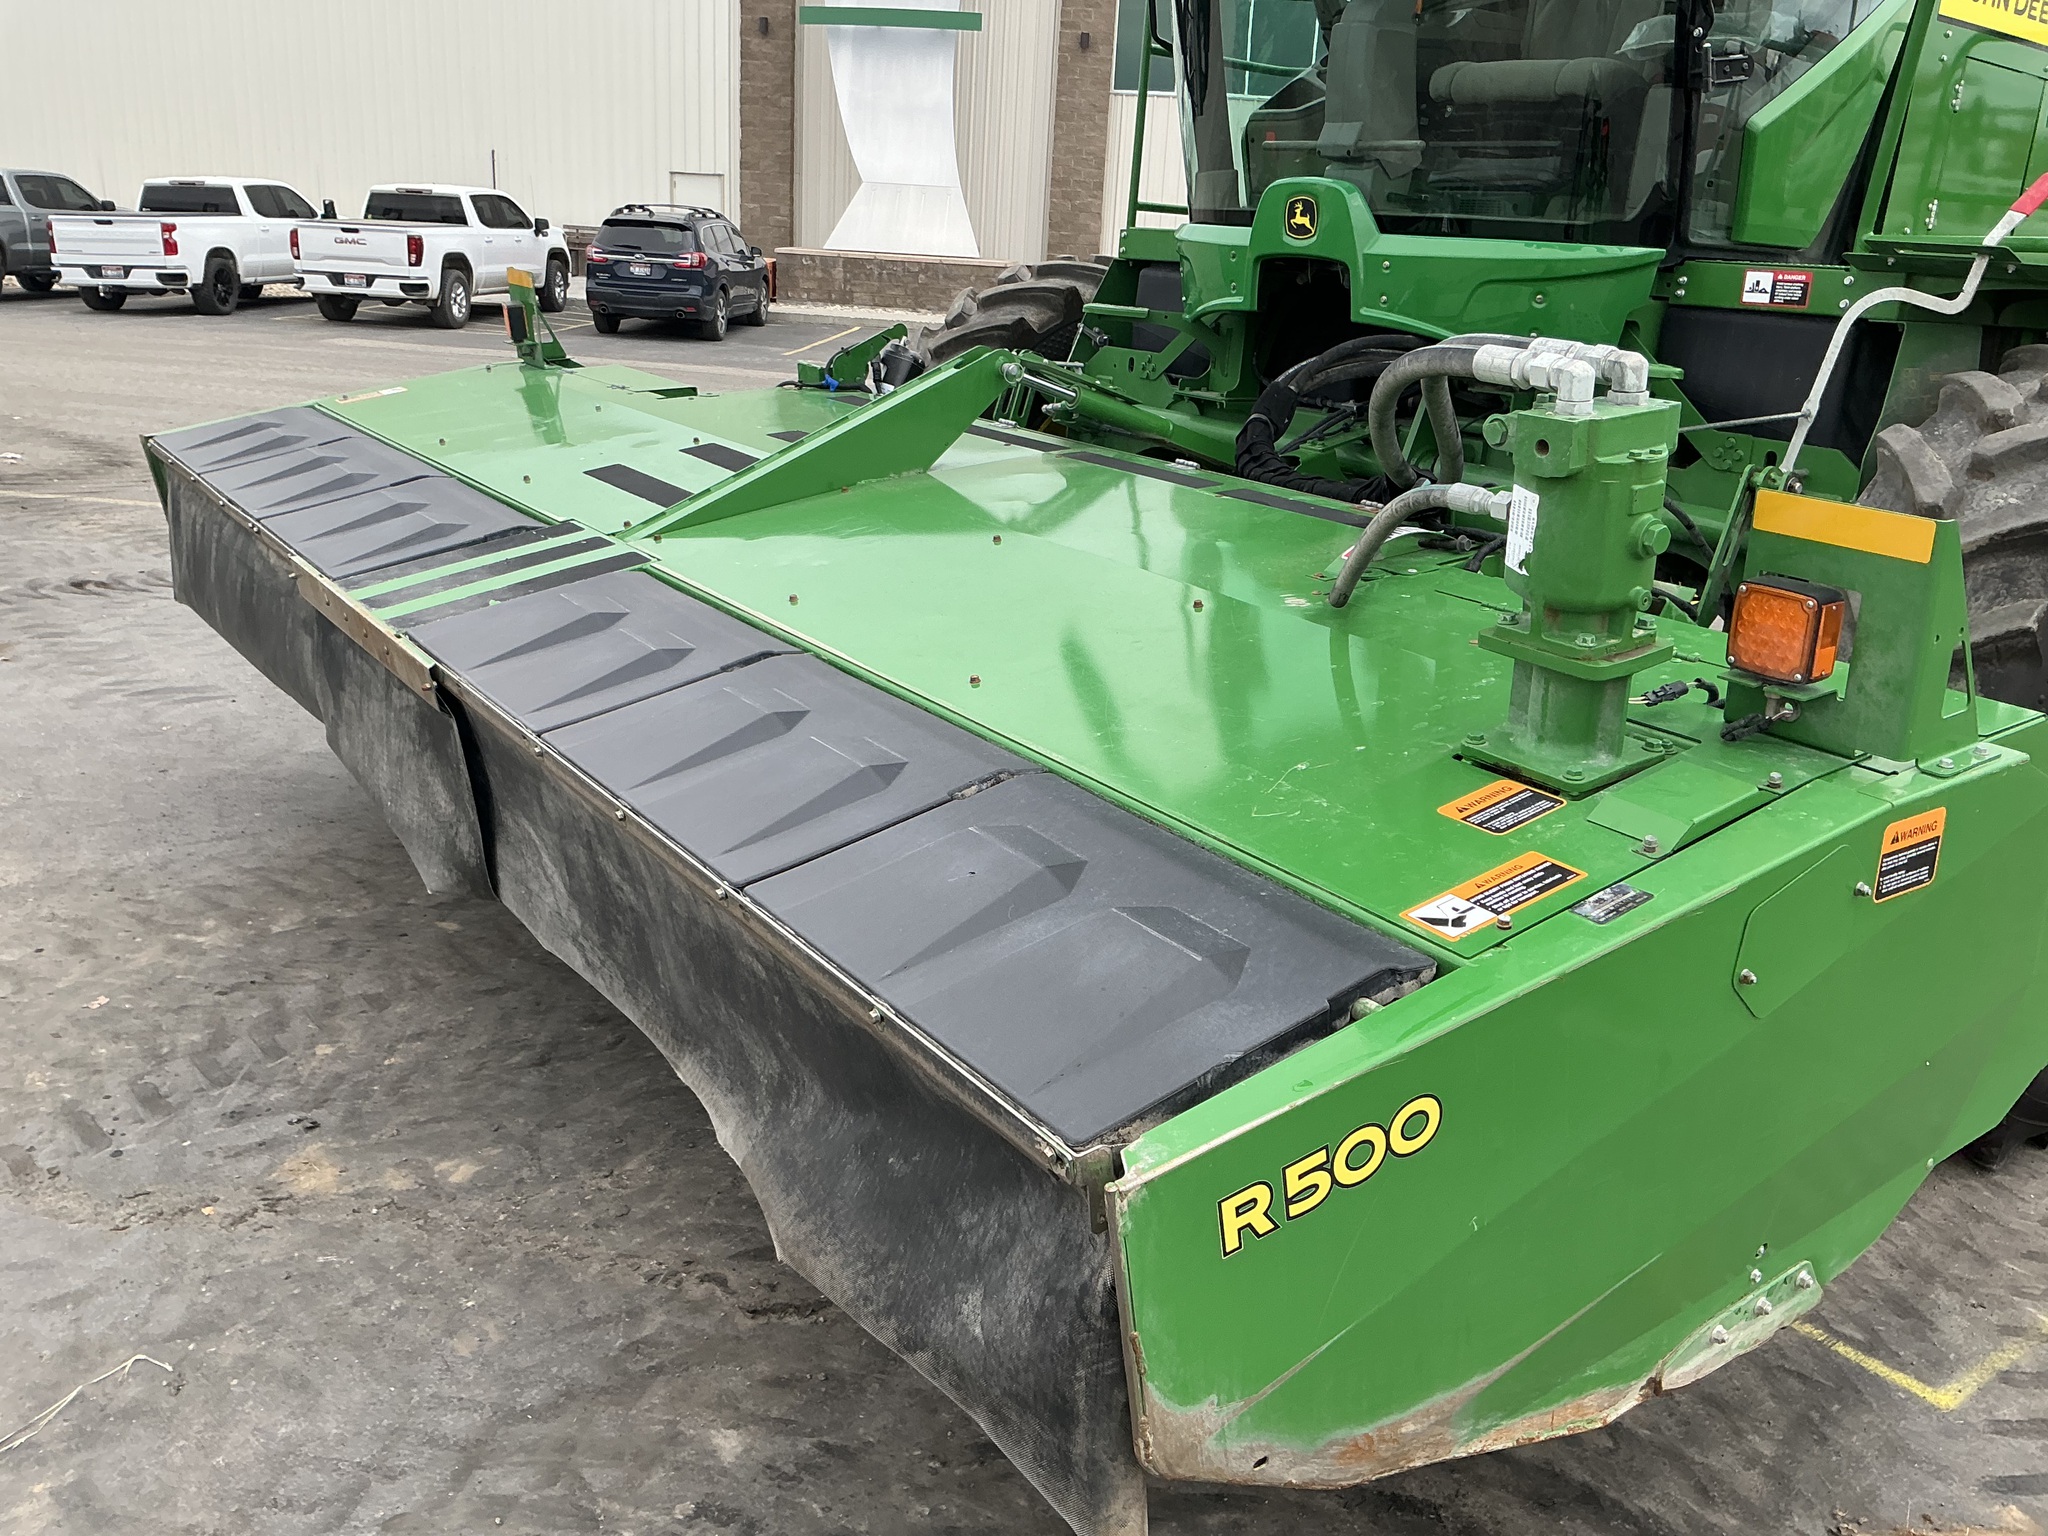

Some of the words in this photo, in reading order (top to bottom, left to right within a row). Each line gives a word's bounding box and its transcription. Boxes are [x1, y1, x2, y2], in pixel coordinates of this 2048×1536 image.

[334, 236, 368, 246] GMC
[1466, 785, 1513, 808] WARNING
[1900, 820, 1938, 842] WARNING
[1482, 864, 1524, 887] WARNING
